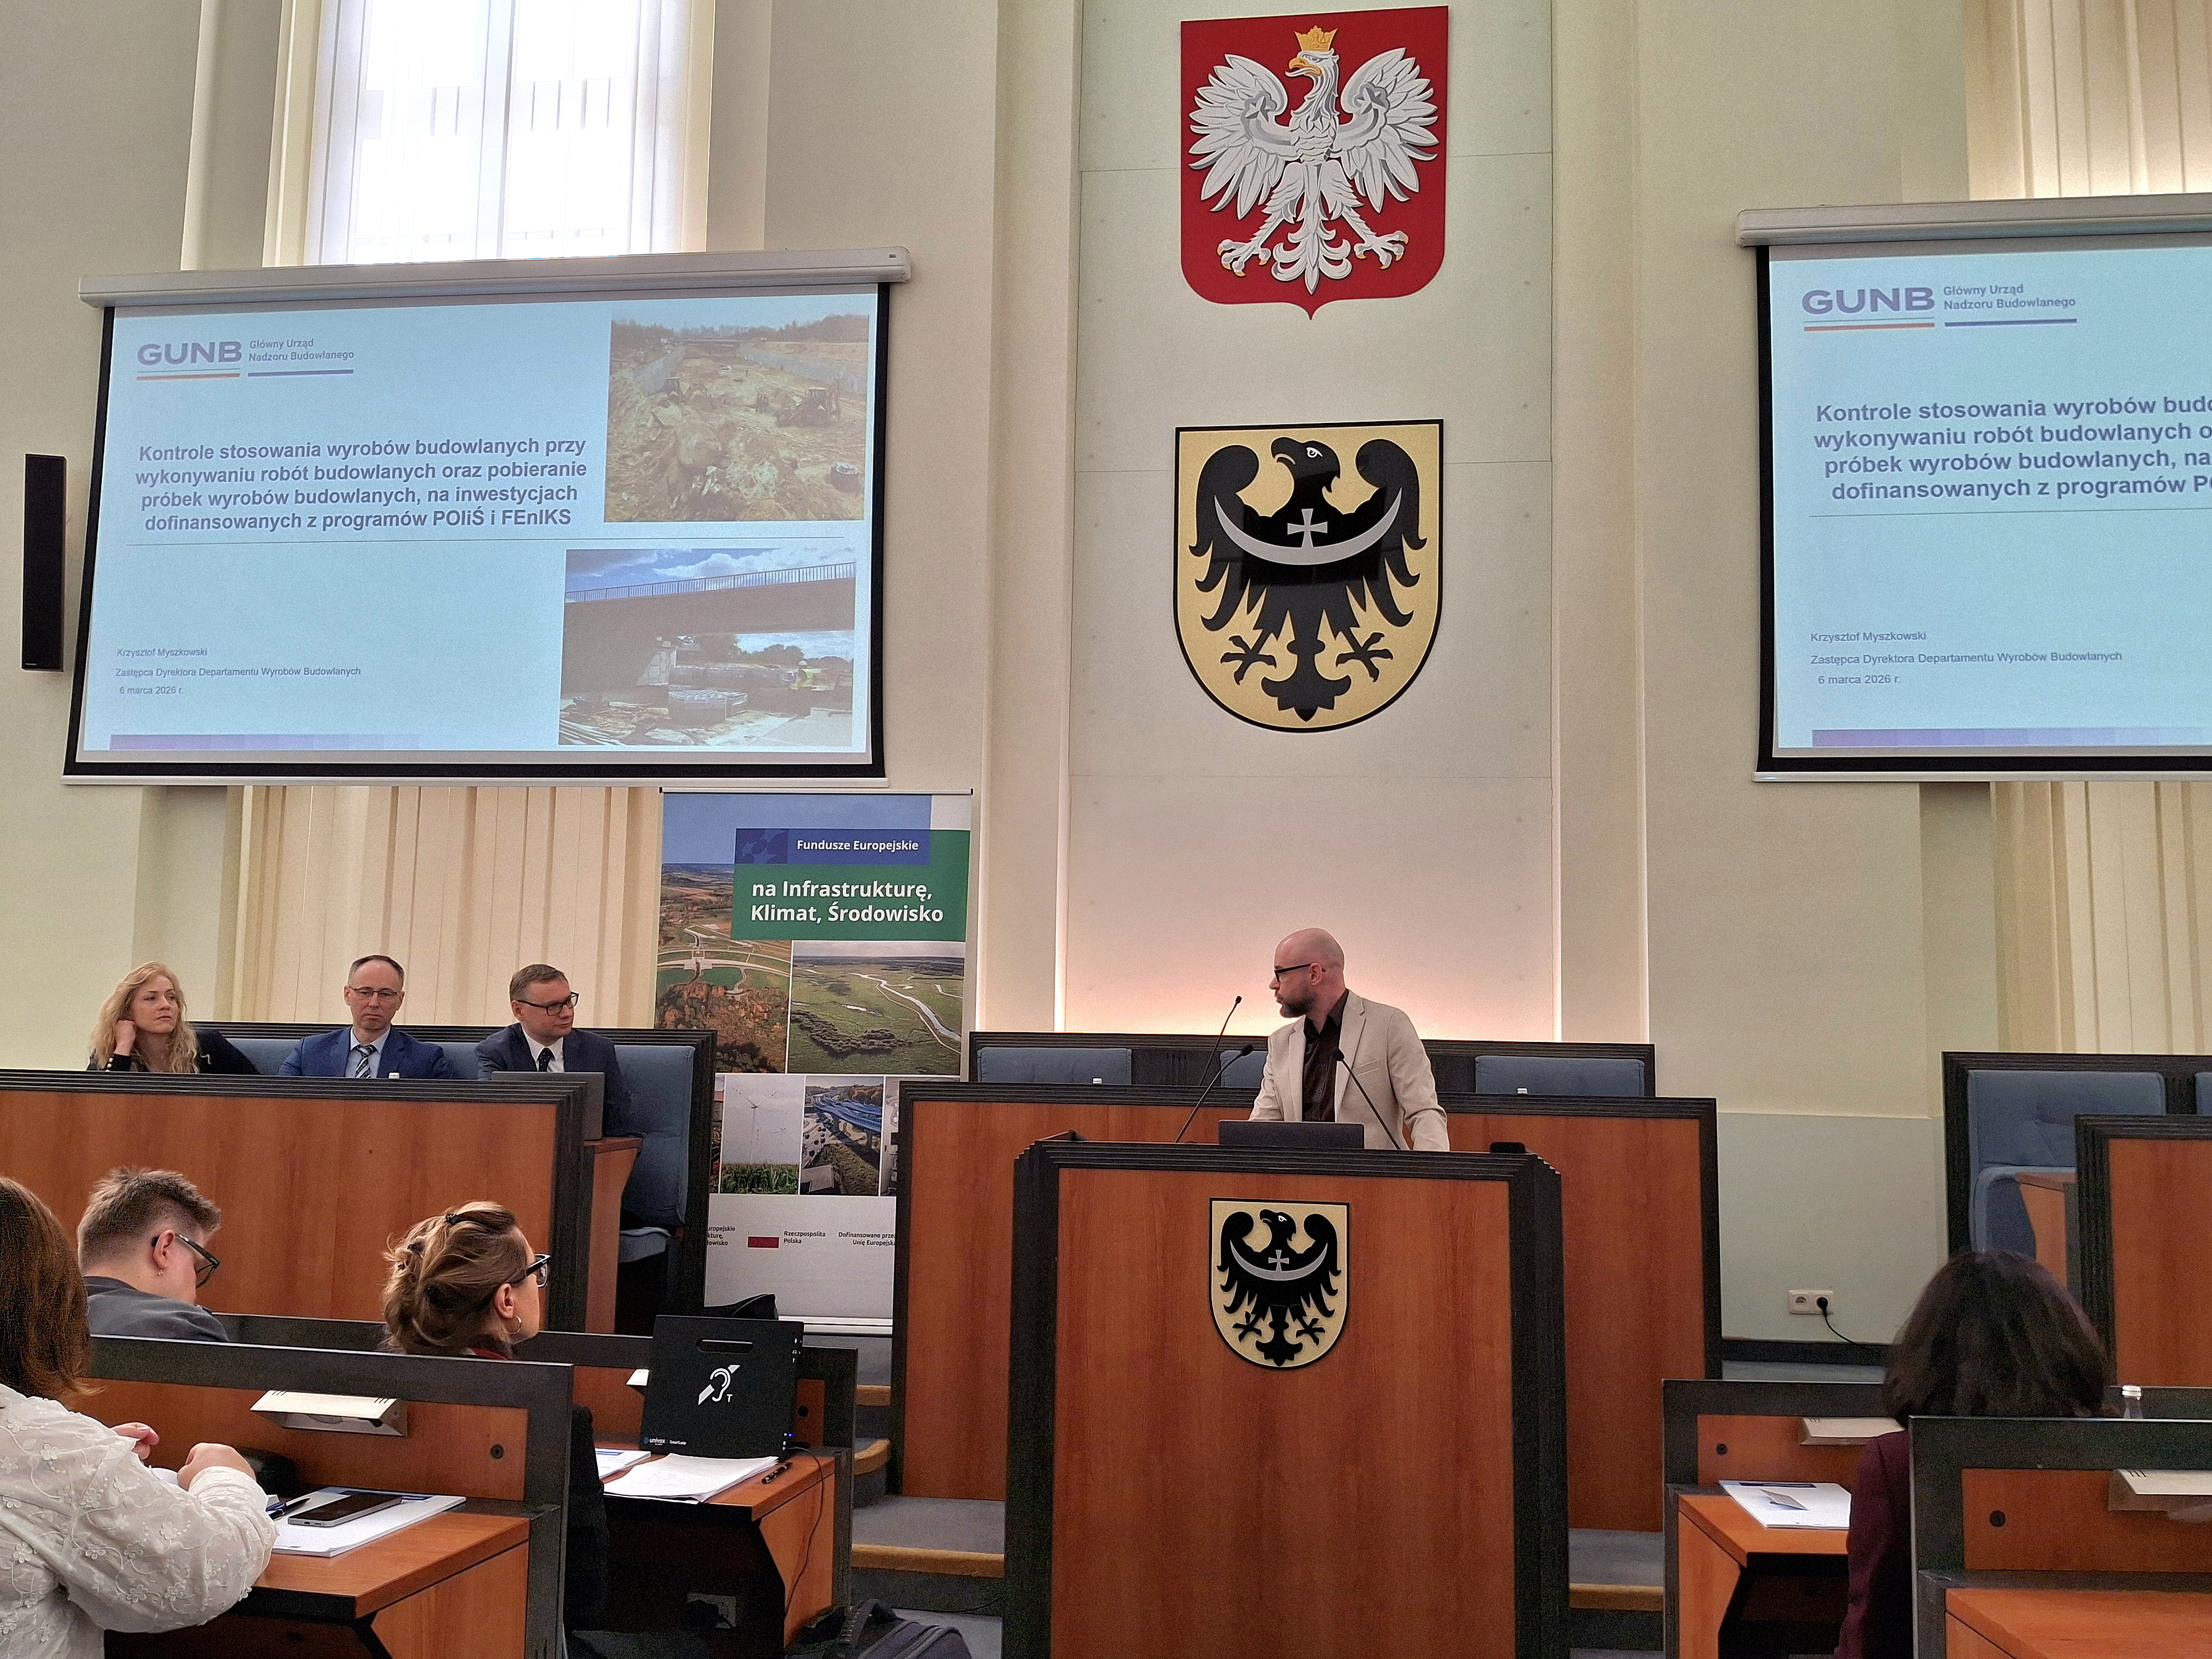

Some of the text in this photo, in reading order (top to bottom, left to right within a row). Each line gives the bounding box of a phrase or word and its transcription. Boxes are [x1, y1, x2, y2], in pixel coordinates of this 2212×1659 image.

[1802, 287, 1935, 314] GUNB
[1943, 284, 2024, 297] Główny Urząd
[1944, 297, 2076, 310] Nadzoru Budowlanego
[138, 341, 242, 365] GUNB
[249, 338, 314, 350] Główny Urząd
[249, 350, 355, 362] Nadzoru Budowlanego
[1817, 403, 1911, 422] Kontrole
[1919, 400, 2046, 419] stosowania
[2053, 397, 2156, 420] wyrobów
[1814, 427, 1966, 452] wykonywaniu
[1973, 426, 2034, 444] robót
[2040, 422, 2191, 445] budowlanych
[139, 438, 586, 461] Kontrole stosowania wyrobów budowlanych przy
[1825, 449, 2211, 478] próbek wyrobów budowlanych, na
[135, 461, 587, 488] wykonywaniu robót budowlanych oraz pobieranie
[141, 485, 577, 511] próbek wyrobów budowlanych, na inwestycjach
[1832, 475, 2212, 501] dofinansowanych z programów P
[145, 512, 301, 532] dofinansowanych
[307, 516, 317, 528] z
[323, 512, 428, 531] programów
[491, 510, 495, 525] i
[501, 509, 571, 525] FEnIKS
[1810, 631, 1926, 644] Krzysztof Myszkowski
[117, 648, 208, 658] Krzysztof Myszkowski
[1810, 652, 2123, 666] Zastępca Dyrektora Departamentu Wyrobów Budowlanych
[115, 667, 361, 678] Zastępca Dyrektora Departamentu Wyrobów Budowlanych
[1818, 676, 1825, 684] 6
[1864, 674, 1891, 684] 2026
[119, 686, 125, 695] 6
[155, 686, 176, 695] 2026
[797, 840, 918, 853] Fundusze Europejskie
[753, 880, 932, 901] na Infrastrukturę,
[751, 902, 943, 924] Klimat, Środowisko
